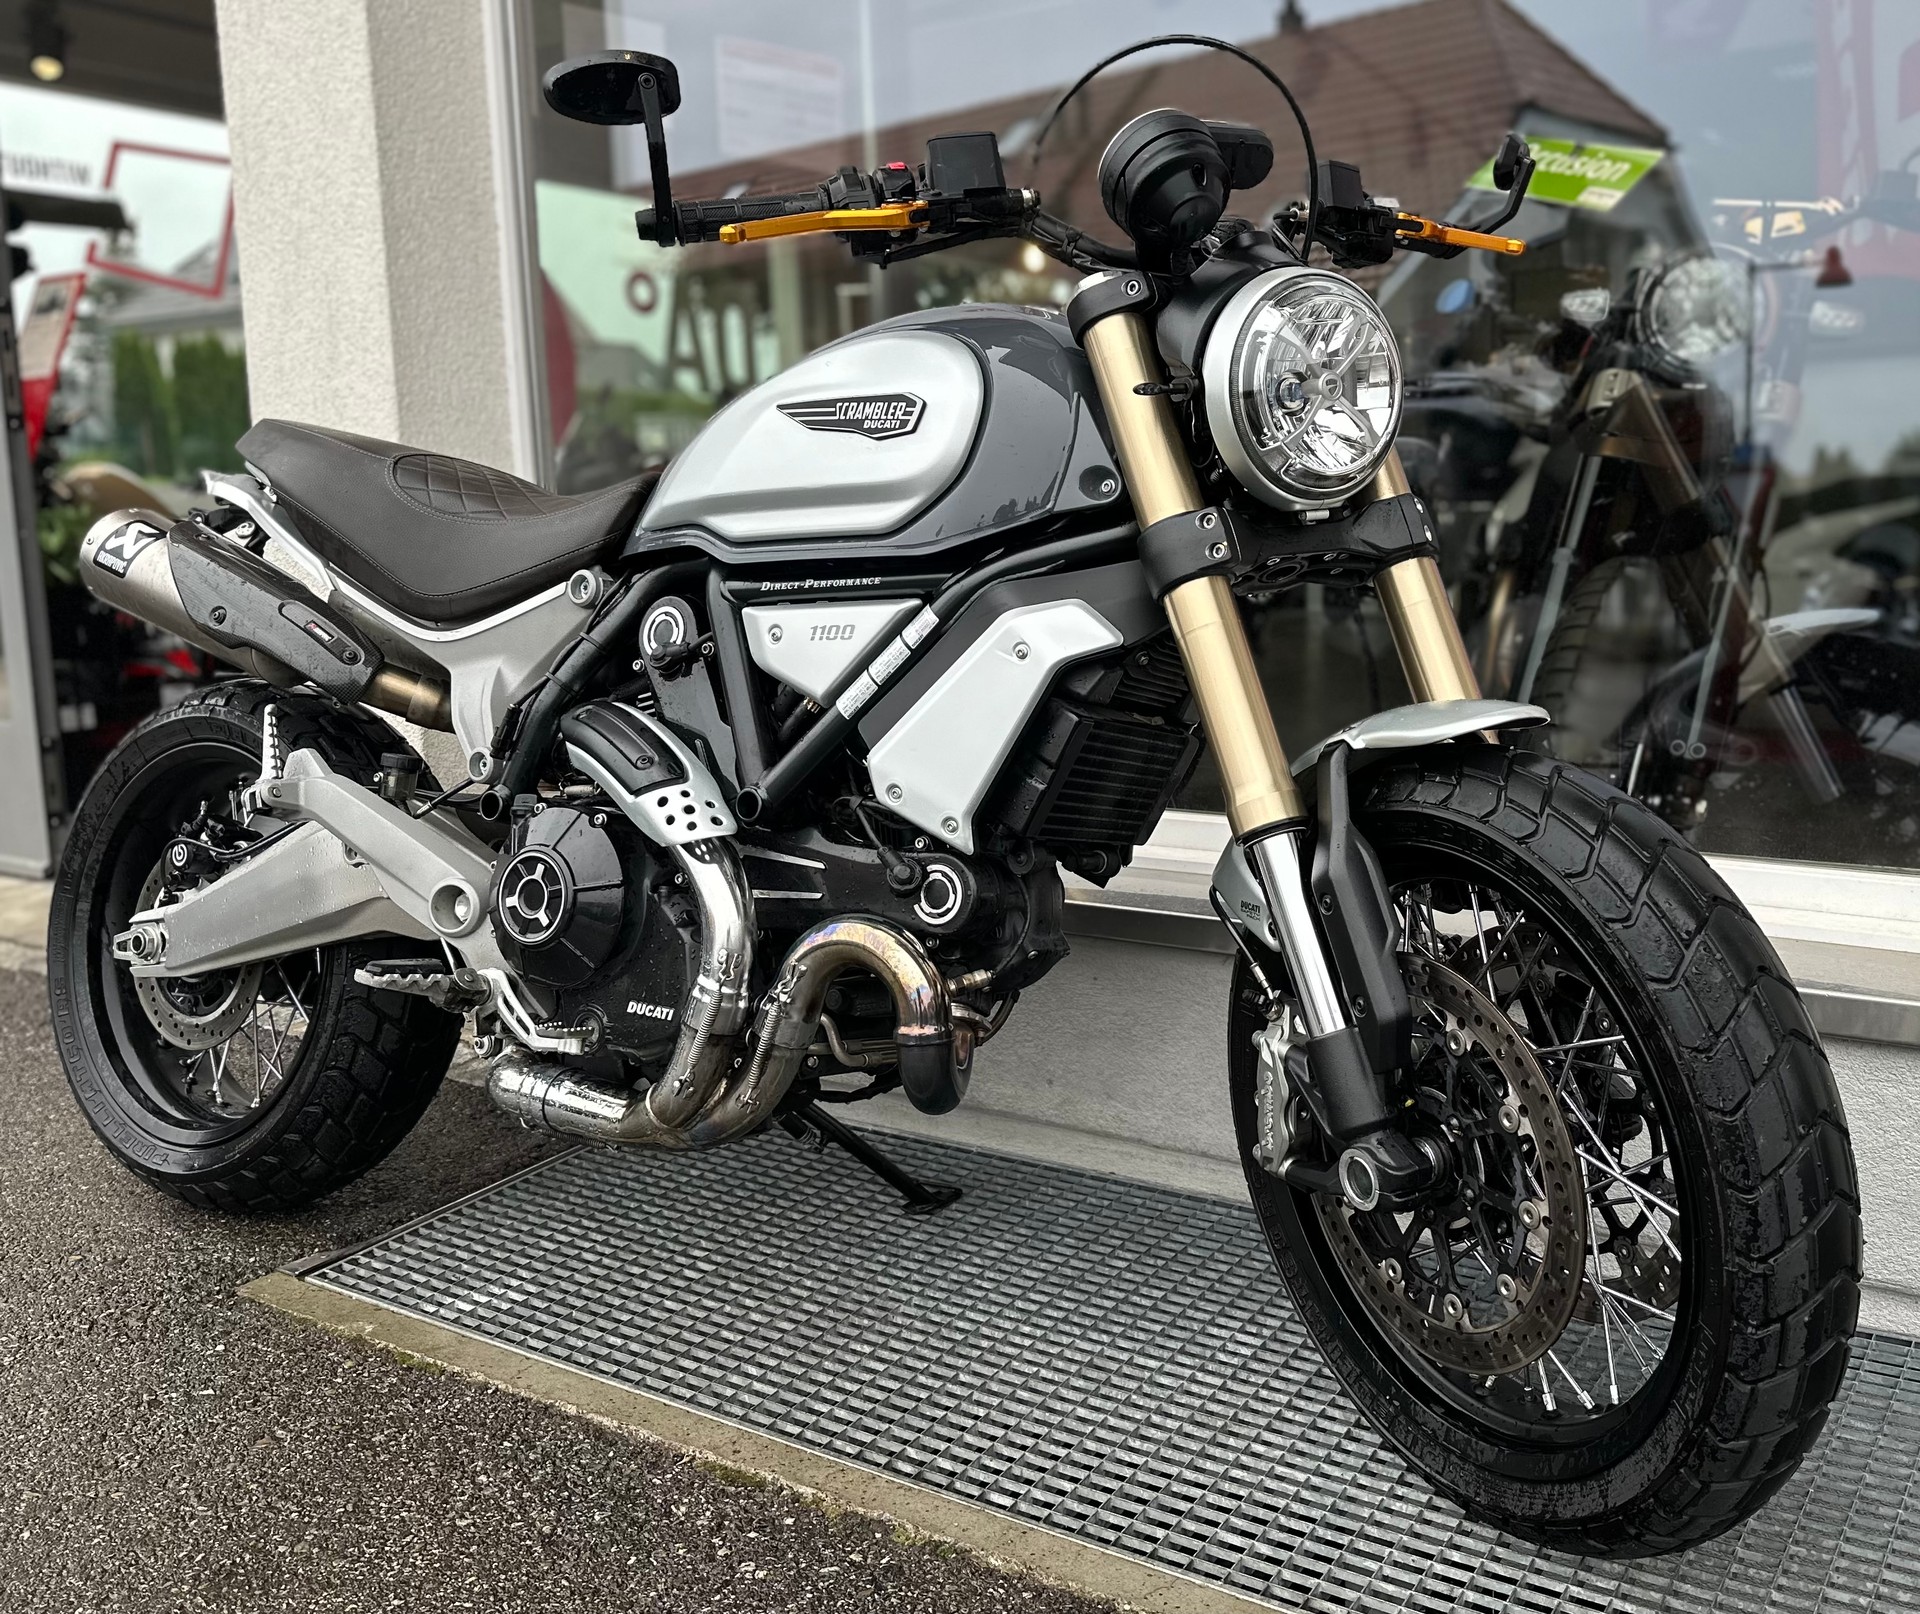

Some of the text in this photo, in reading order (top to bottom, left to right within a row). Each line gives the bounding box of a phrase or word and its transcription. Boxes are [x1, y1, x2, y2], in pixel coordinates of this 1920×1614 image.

[836, 402, 906, 420] SCRAMBLER
[863, 419, 900, 429] DUCATI
[809, 624, 856, 641] 1100
[1240, 900, 1260, 913] DUCATI
[627, 1001, 675, 1021] DUCATI
[1260, 1071, 1274, 1151] brembo
